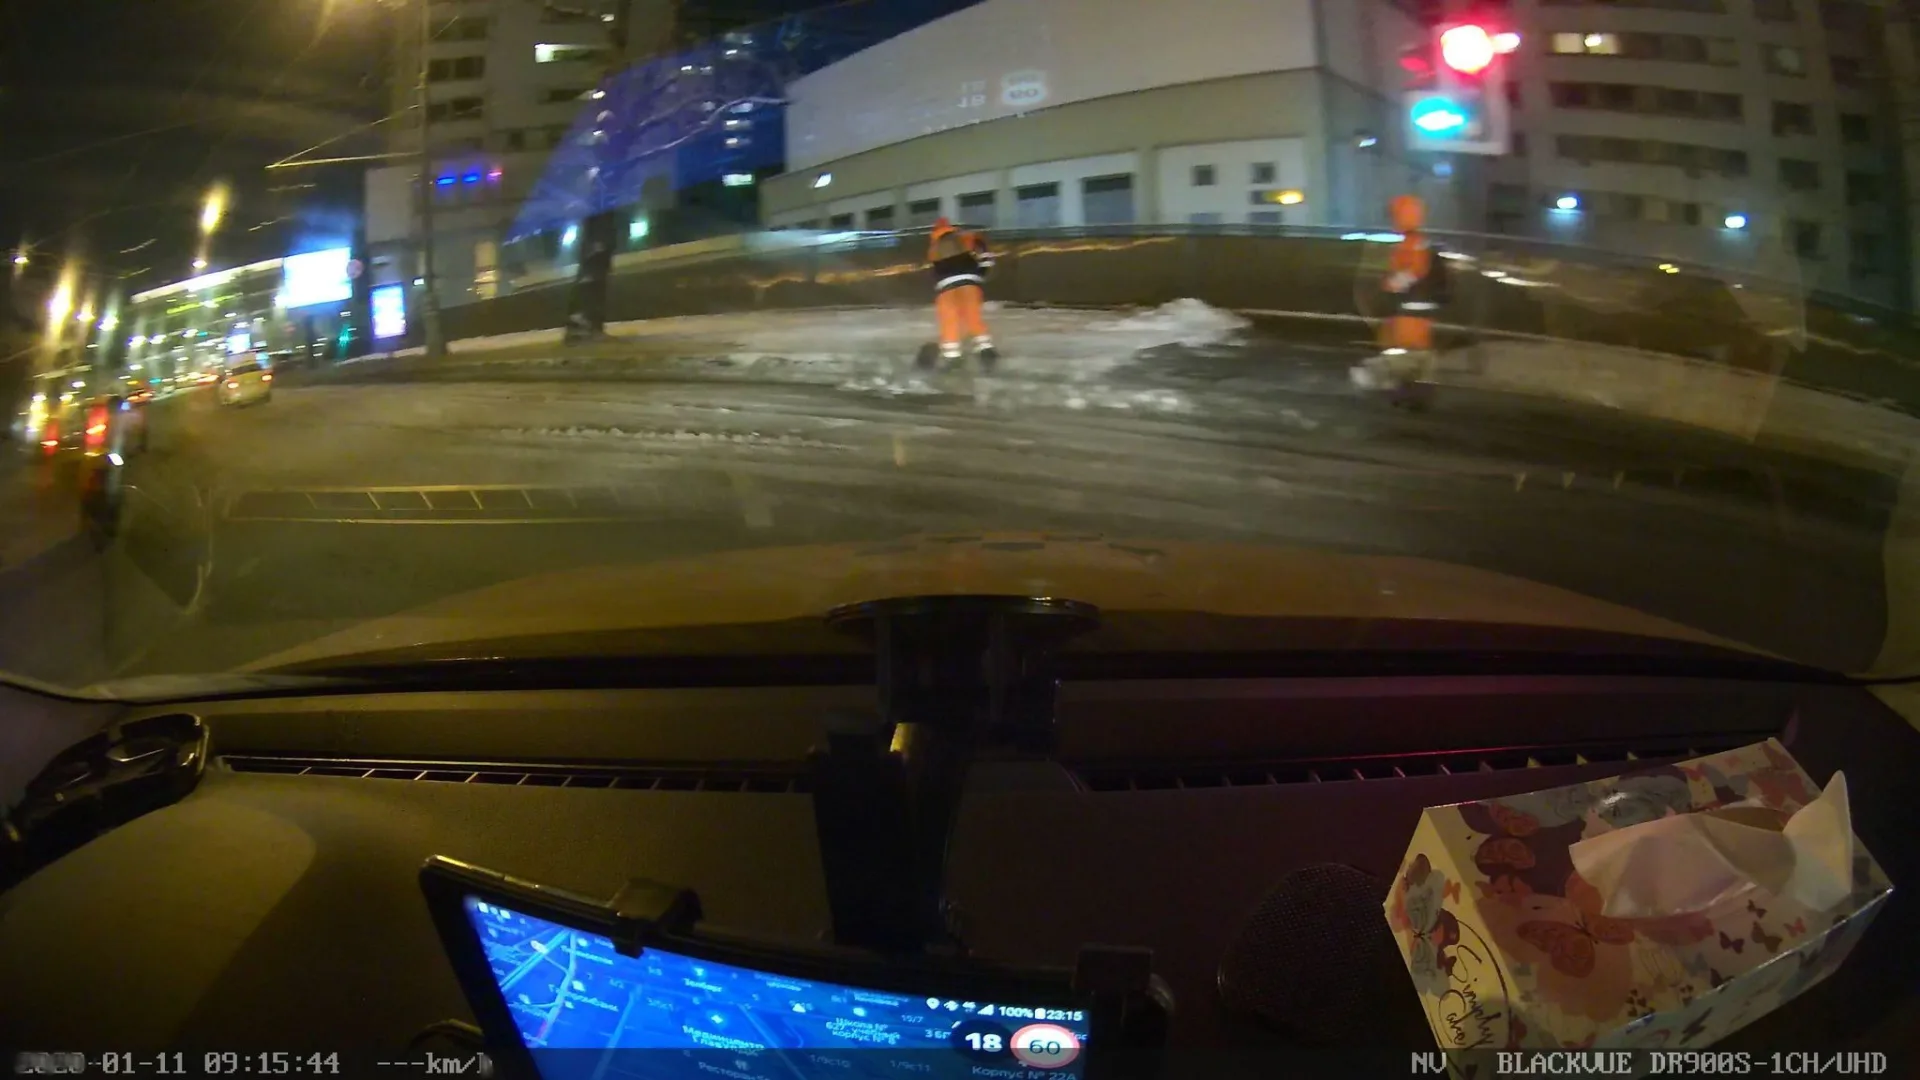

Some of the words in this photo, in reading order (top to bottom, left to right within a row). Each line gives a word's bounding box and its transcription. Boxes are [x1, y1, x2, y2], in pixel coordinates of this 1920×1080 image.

[1451, 945, 1501, 1051] Simply
[999, 1006, 1034, 1018] 100%
[1047, 1009, 1083, 1021] 23:15
[1439, 990, 1467, 1045] Care
[965, 1032, 1003, 1053] 18
[1029, 1039, 1060, 1055] 60
[972, 1066, 1024, 1079] Корпус
